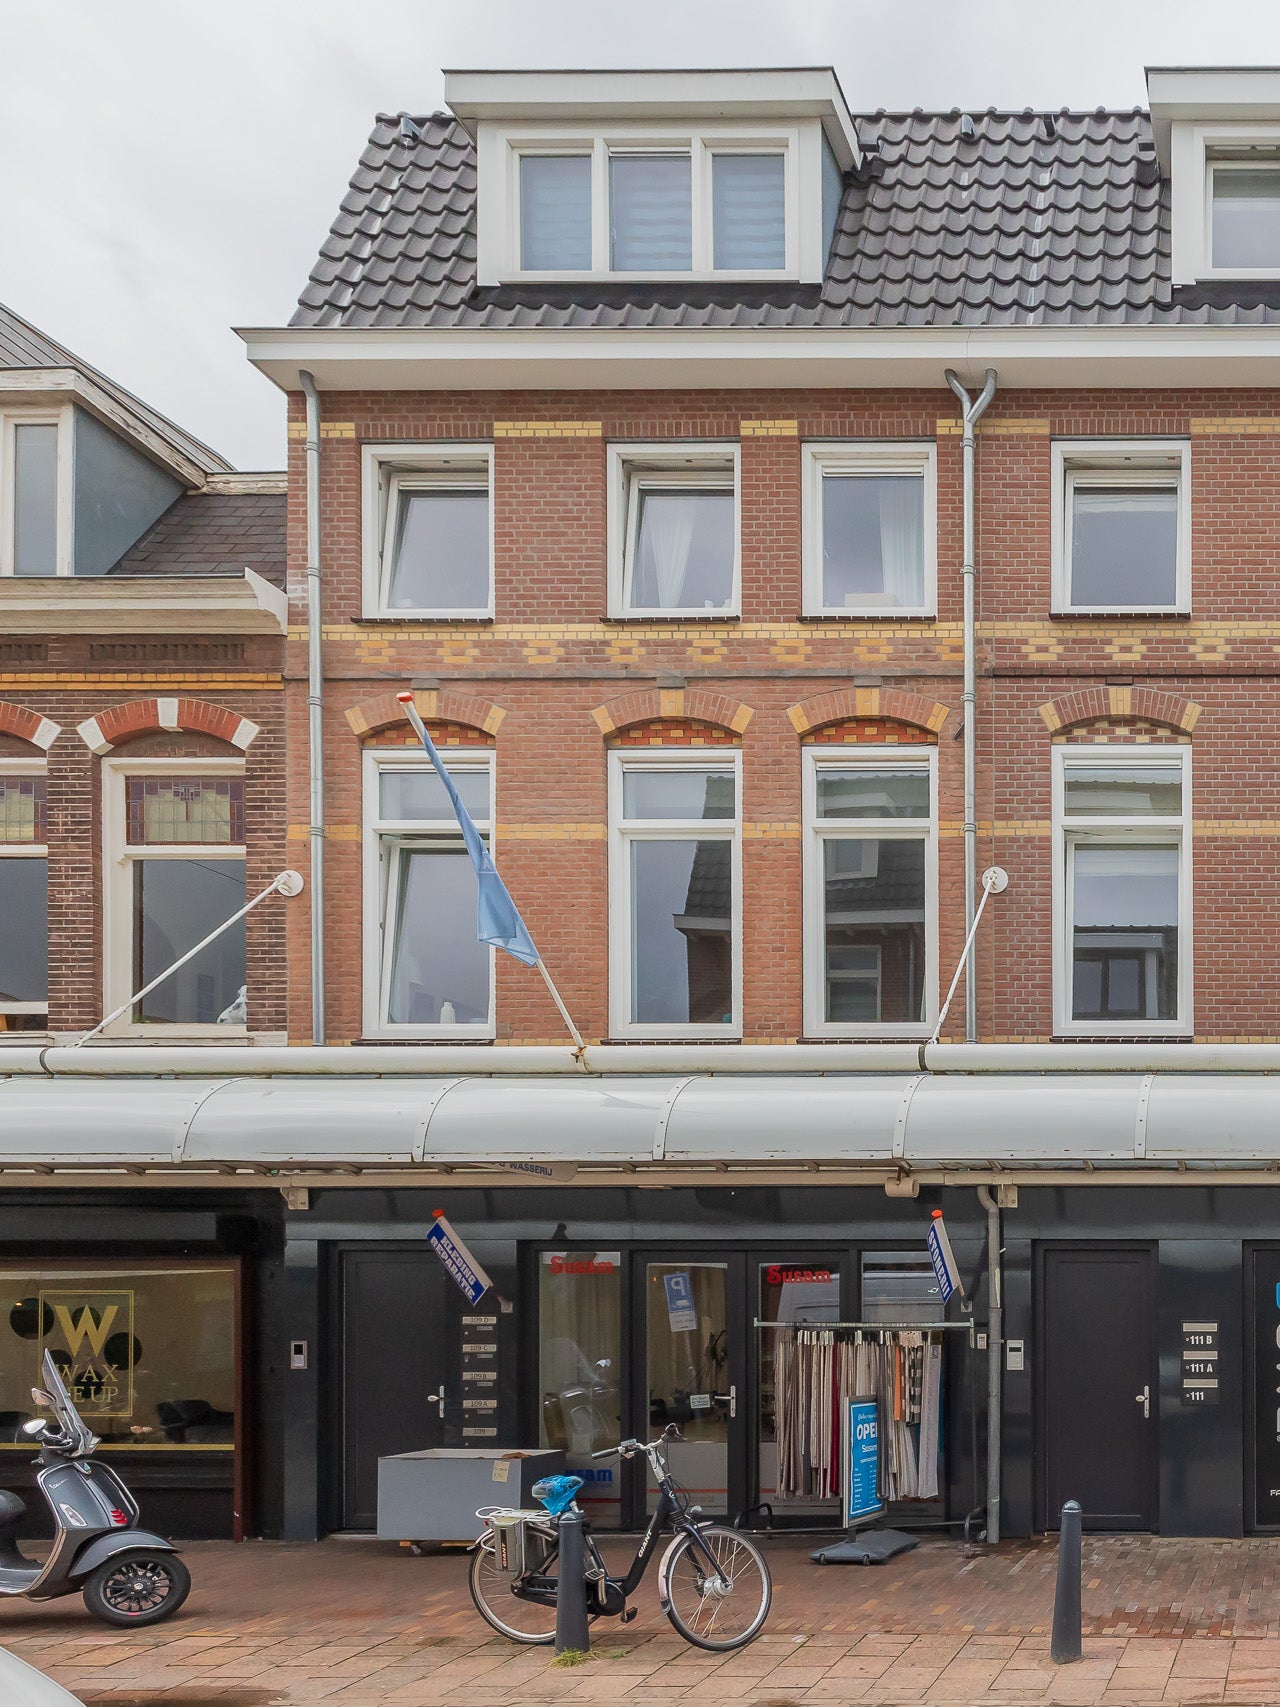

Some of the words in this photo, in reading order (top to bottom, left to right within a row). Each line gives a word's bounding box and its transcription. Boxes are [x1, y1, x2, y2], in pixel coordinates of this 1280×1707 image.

[509, 1162, 552, 1176] WASSERIJ
[430, 1236, 476, 1300] REPARATIE
[440, 1235, 477, 1286] KLEDING
[550, 1256, 613, 1275] Susam
[928, 1230, 950, 1298] STOMERIJ
[767, 1265, 832, 1284] Susam
[54, 1304, 119, 1357] W
[1190, 1335, 1204, 1345] 111
[1206, 1335, 1213, 1345] B
[57, 1364, 119, 1382] WAX
[1190, 1363, 1204, 1373] 111
[1206, 1363, 1213, 1373] A
[66, 1386, 84, 1403] E
[89, 1386, 119, 1403] UP
[1190, 1391, 1204, 1401] 111
[856, 1422, 878, 1441] OPE
[639, 1530, 653, 1558] GIANT
